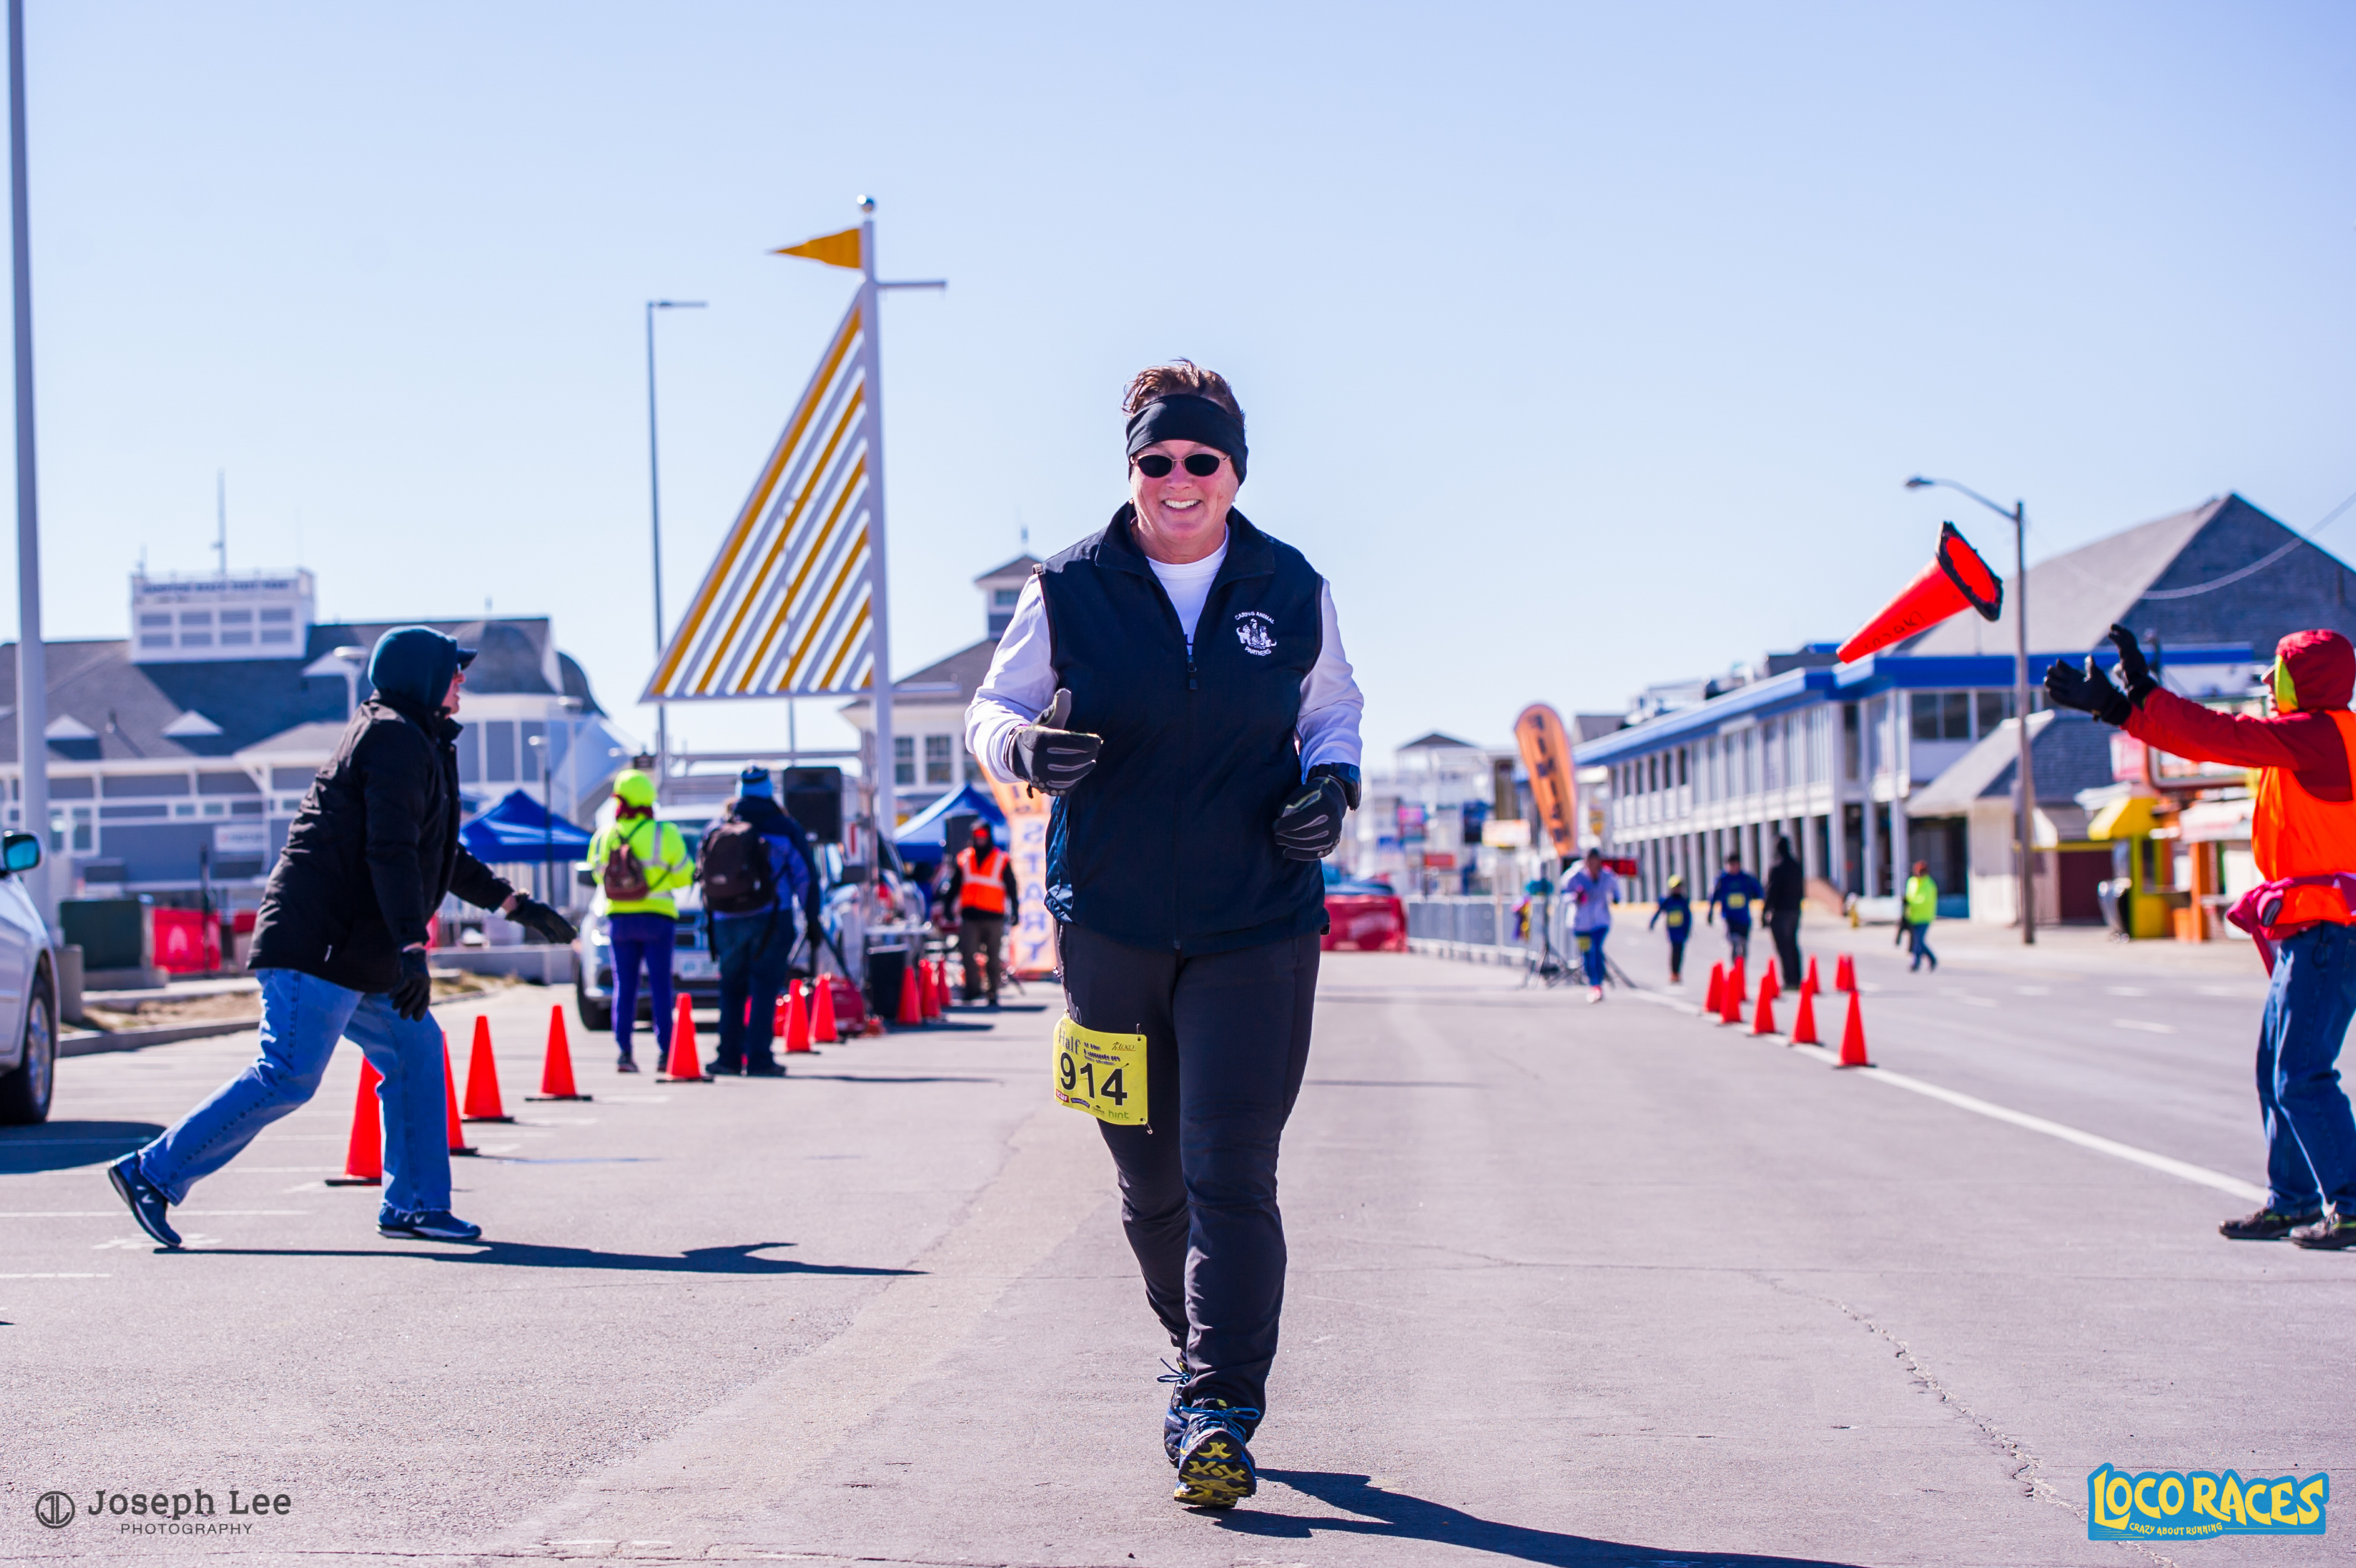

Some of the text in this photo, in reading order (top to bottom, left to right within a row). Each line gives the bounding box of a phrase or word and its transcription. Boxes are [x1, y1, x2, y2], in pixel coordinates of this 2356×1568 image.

[1256, 611, 1275, 624] ANIMAL
[1244, 646, 1272, 656] PARTNERS
[1058, 1026, 1081, 1055] Half
[1060, 1051, 1128, 1106] 914
[1108, 1109, 1130, 1119] hint
